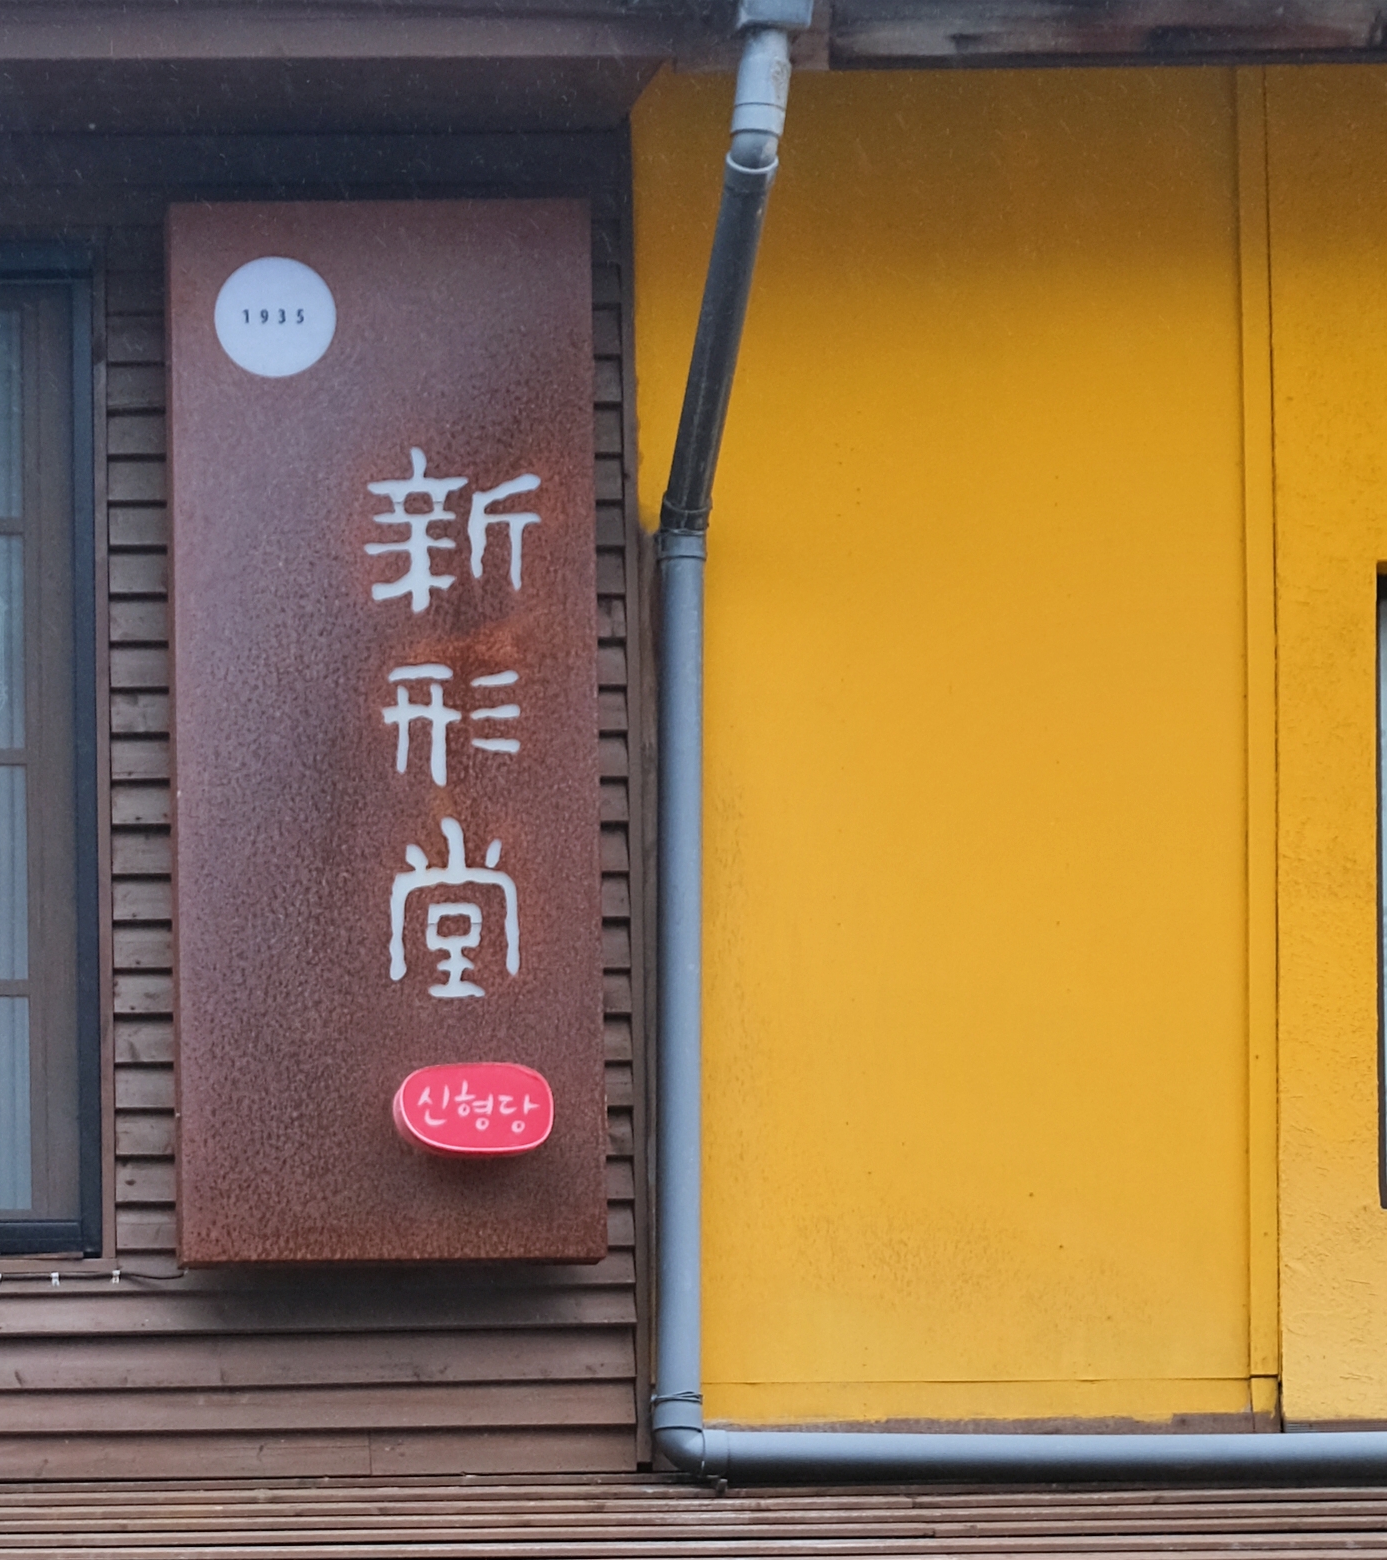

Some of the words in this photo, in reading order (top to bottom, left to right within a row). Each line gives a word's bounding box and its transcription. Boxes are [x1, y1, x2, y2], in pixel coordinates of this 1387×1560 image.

[241, 307, 307, 325] 1935
[363, 445, 542, 998] 新形堂
[415, 1082, 542, 1135] 신형당
